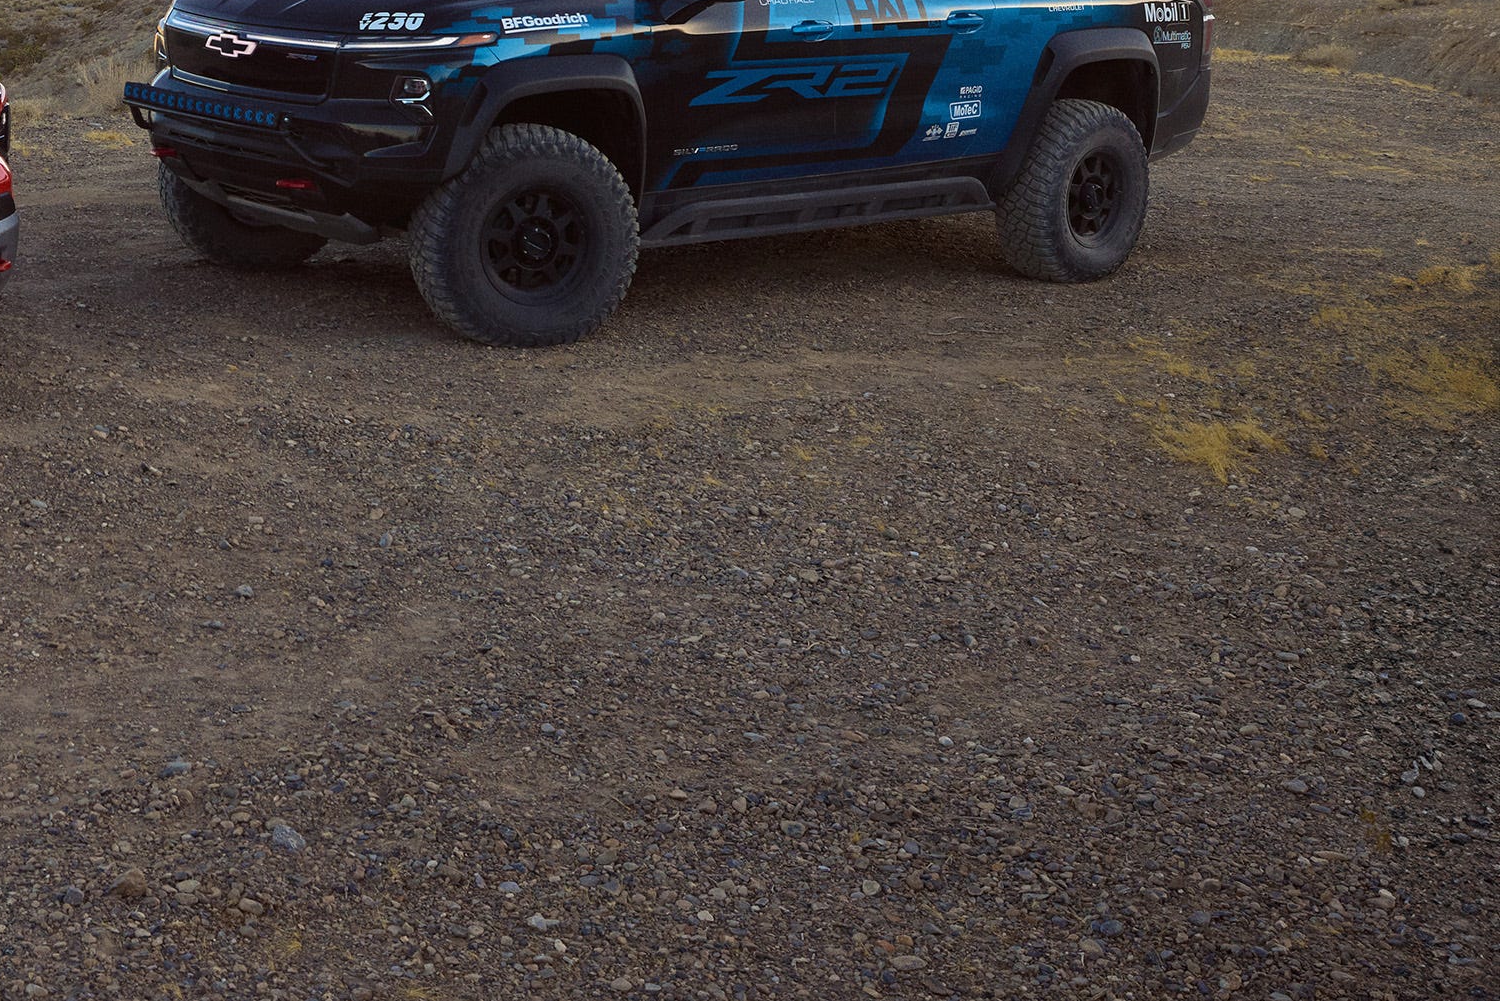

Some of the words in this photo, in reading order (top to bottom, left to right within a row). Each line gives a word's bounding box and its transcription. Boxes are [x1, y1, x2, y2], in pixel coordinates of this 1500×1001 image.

[1048, 4, 1085, 13] CHEVROLET
[1143, 2, 1179, 23] Mobil
[368, 11, 426, 31] 230
[501, 12, 589, 30] BFGoodrich
[1162, 30, 1191, 41] Multimatic
[688, 62, 898, 108] ZR2
[953, 103, 979, 118] MoTeC
